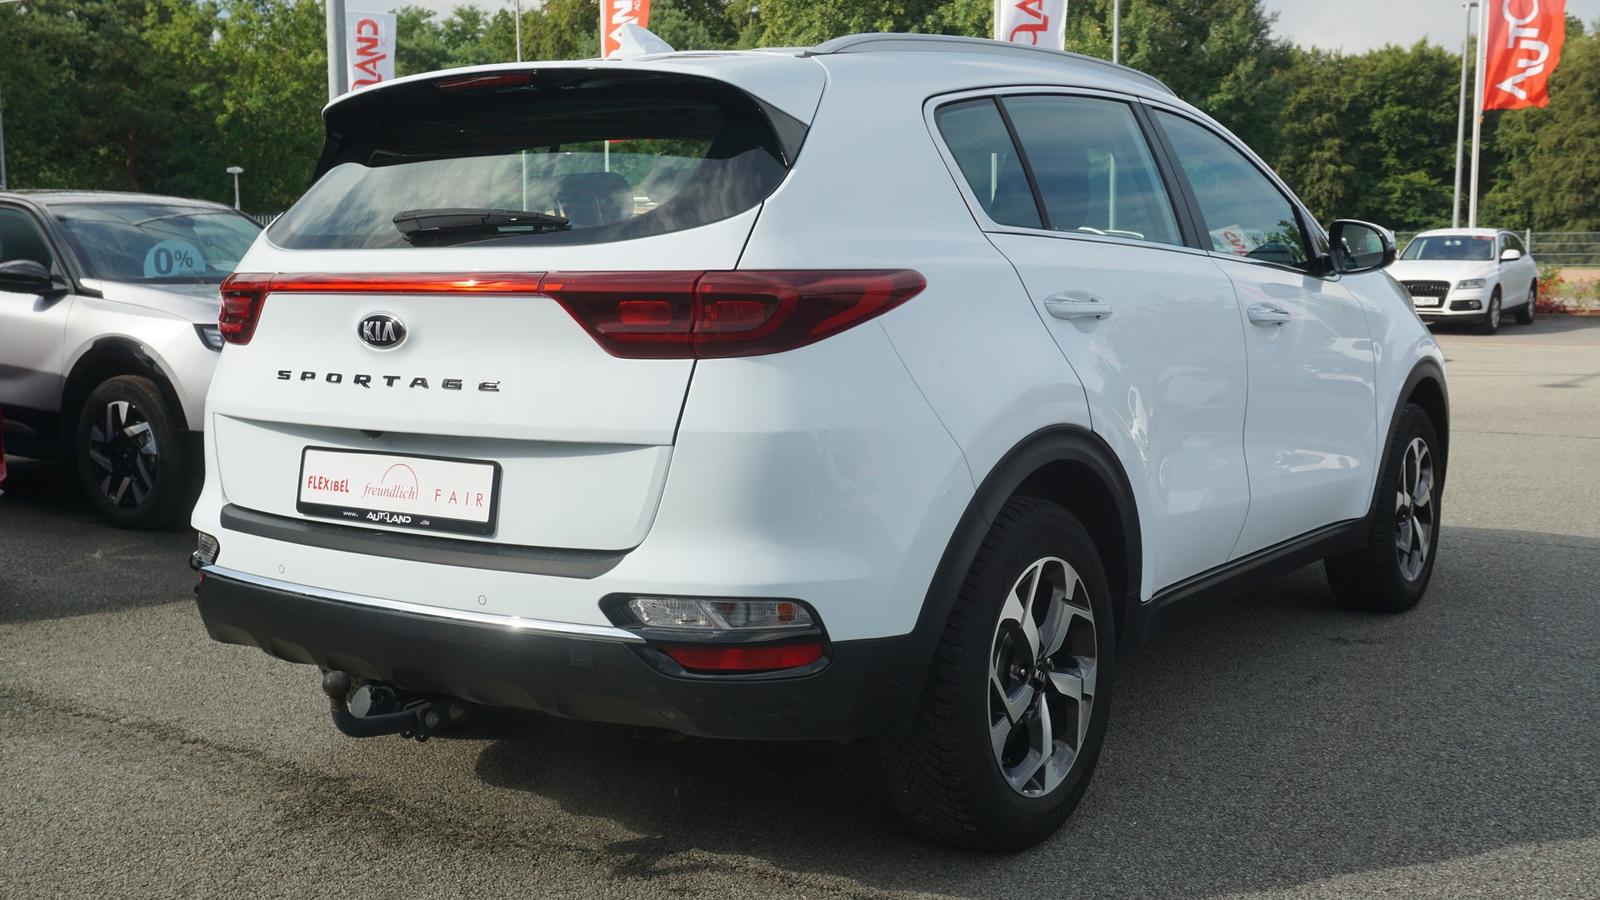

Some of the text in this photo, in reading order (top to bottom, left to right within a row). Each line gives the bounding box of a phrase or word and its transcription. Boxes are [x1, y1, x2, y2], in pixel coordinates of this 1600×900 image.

[1495, 0, 1550, 100] AUTO
[154, 247, 194, 276] 0%
[363, 320, 397, 342] KIA
[277, 369, 501, 392] SPORTAGE
[307, 475, 484, 507] FLEXIBEL freundlich FAIR
[366, 511, 412, 524] AUTOLAND
